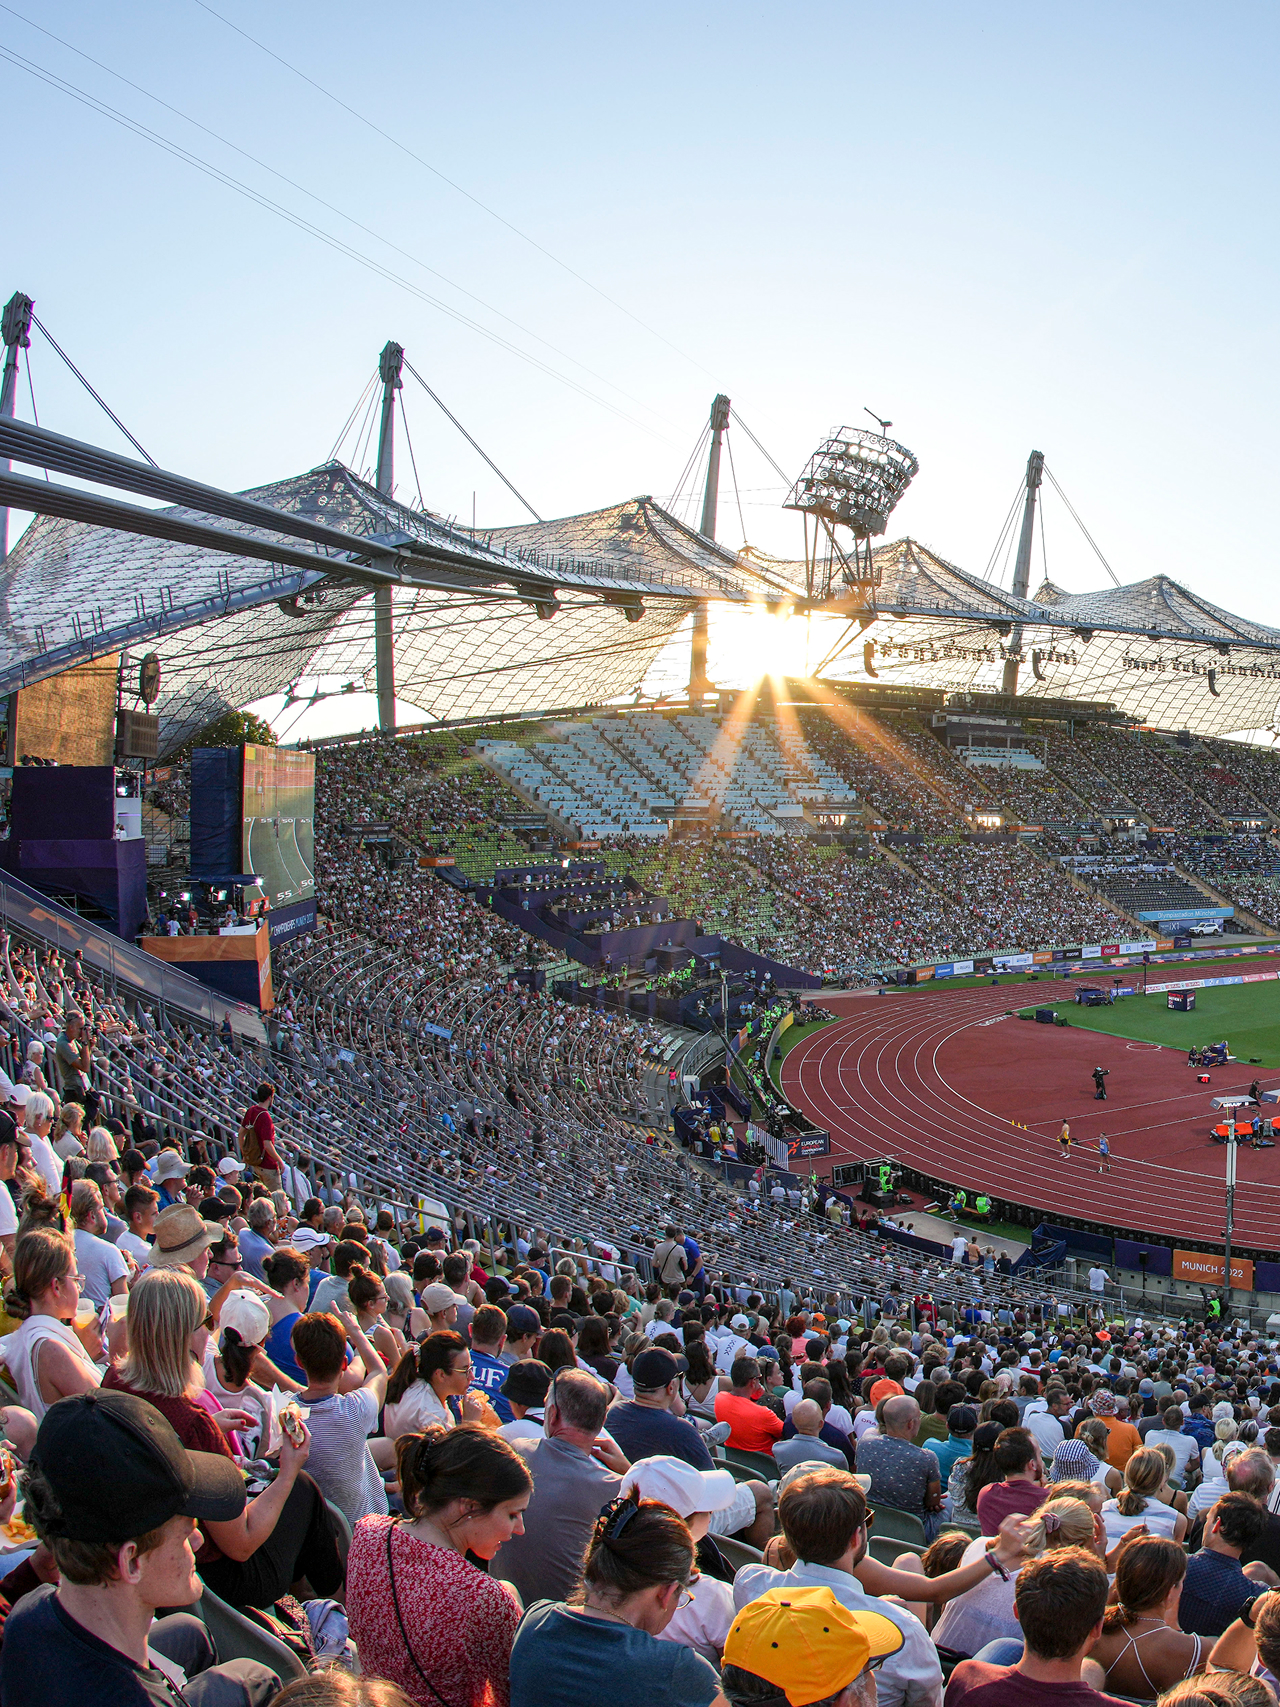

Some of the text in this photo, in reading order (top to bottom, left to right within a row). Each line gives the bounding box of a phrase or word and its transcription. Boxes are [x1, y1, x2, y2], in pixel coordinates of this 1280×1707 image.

[301, 878, 315, 887] 50
[277, 889, 293, 901] 55
[1157, 909, 1217, 920] Olympiastadion München
[341, 1050, 352, 1061] S3
[801, 1139, 825, 1147] EUROPEAN
[1181, 1261, 1218, 1274] MUNICH
